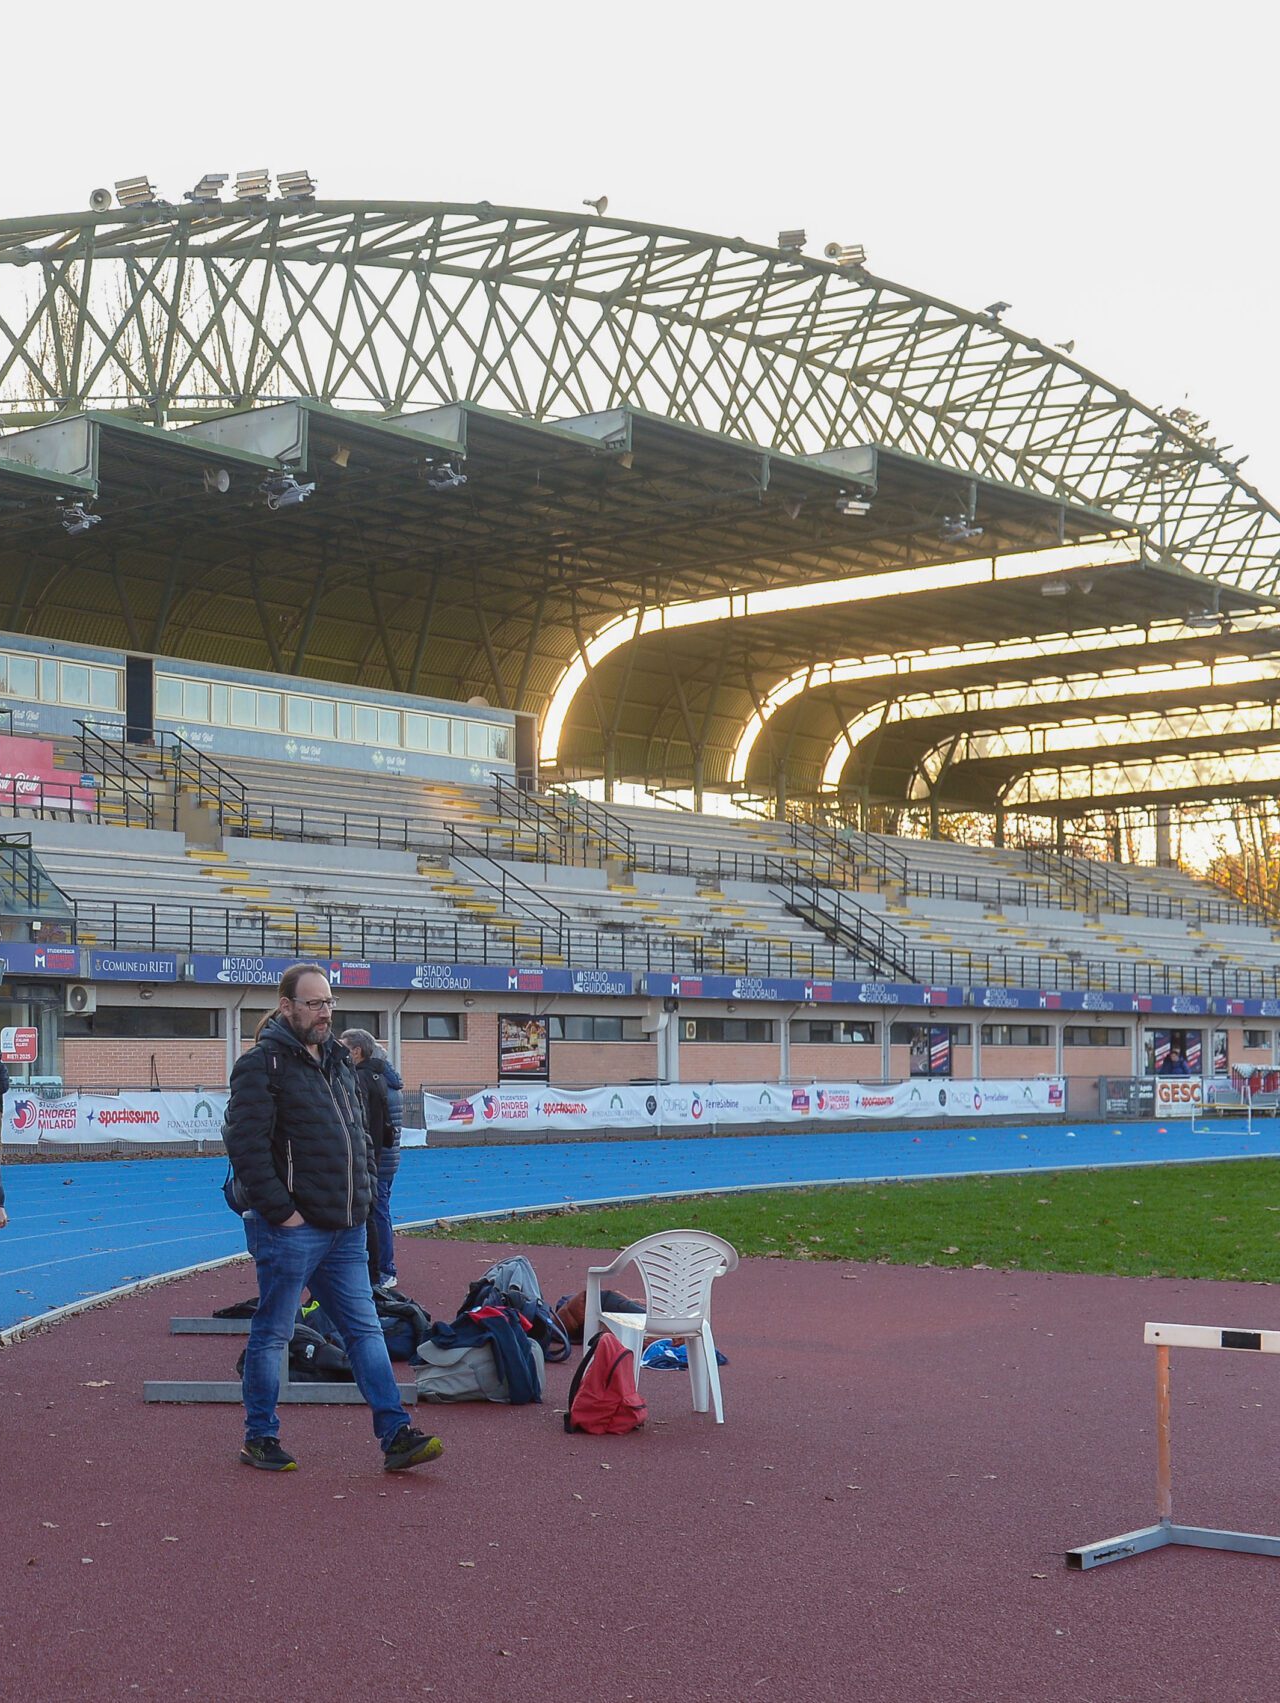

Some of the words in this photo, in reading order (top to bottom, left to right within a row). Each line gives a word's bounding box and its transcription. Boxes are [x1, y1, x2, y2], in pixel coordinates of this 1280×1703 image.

[15, 772, 41, 793] Rieti
[149, 961, 173, 973] RIETI
[230, 957, 263, 970] STADIO
[423, 965, 451, 977] STADIO
[583, 971, 608, 982] STADIO
[230, 970, 283, 984] GUIDOBALD
[422, 978, 470, 989] GUIDOBALDI
[583, 982, 626, 994] GUIDOBALDI
[740, 979, 763, 988] STADIO
[865, 984, 885, 993] STADIO
[740, 988, 778, 999] GUIDOBALDI
[1158, 1083, 1201, 1103] GESC
[501, 1101, 529, 1110] ANDREA
[543, 1102, 588, 1117] sportissimo
[705, 1099, 739, 1109] TerreSabine
[38, 1109, 76, 1118] ANDREA
[98, 1108, 160, 1127] sportissimo
[501, 1110, 529, 1119] MILARDI
[38, 1119, 76, 1129] MILARDI
